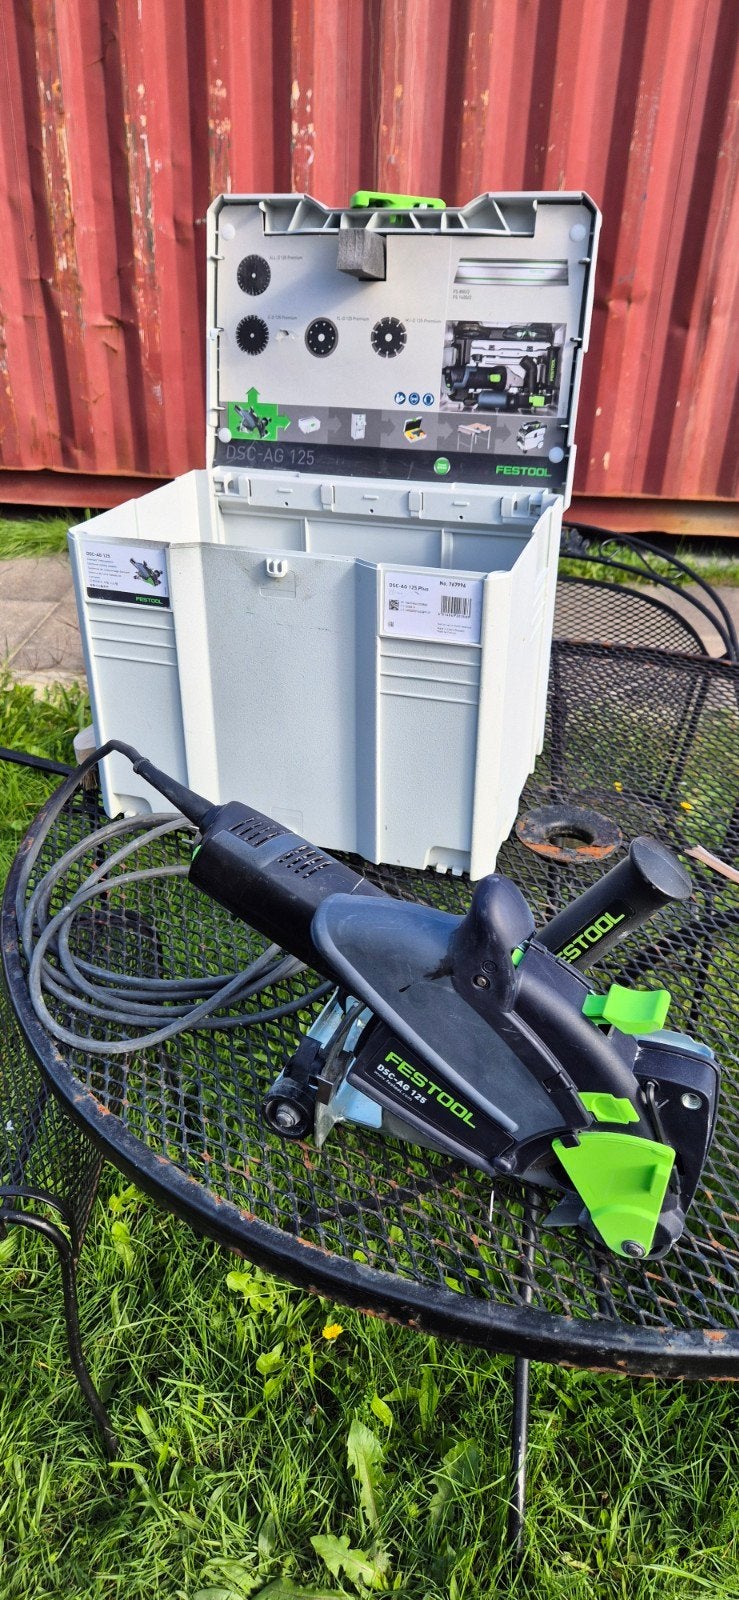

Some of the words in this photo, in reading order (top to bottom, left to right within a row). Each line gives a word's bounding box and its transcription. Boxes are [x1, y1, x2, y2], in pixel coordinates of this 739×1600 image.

[226, 445, 284, 464] DSC-AG
[290, 448, 315, 466] 125
[495, 465, 552, 477] FESTOOL
[135, 596, 164, 605] FESTOOL
[555, 912, 626, 964] ESTOOL
[376, 1063, 411, 1092] DSC-AG
[411, 1089, 428, 1104] 125
[384, 1051, 476, 1129] FESTOOL
